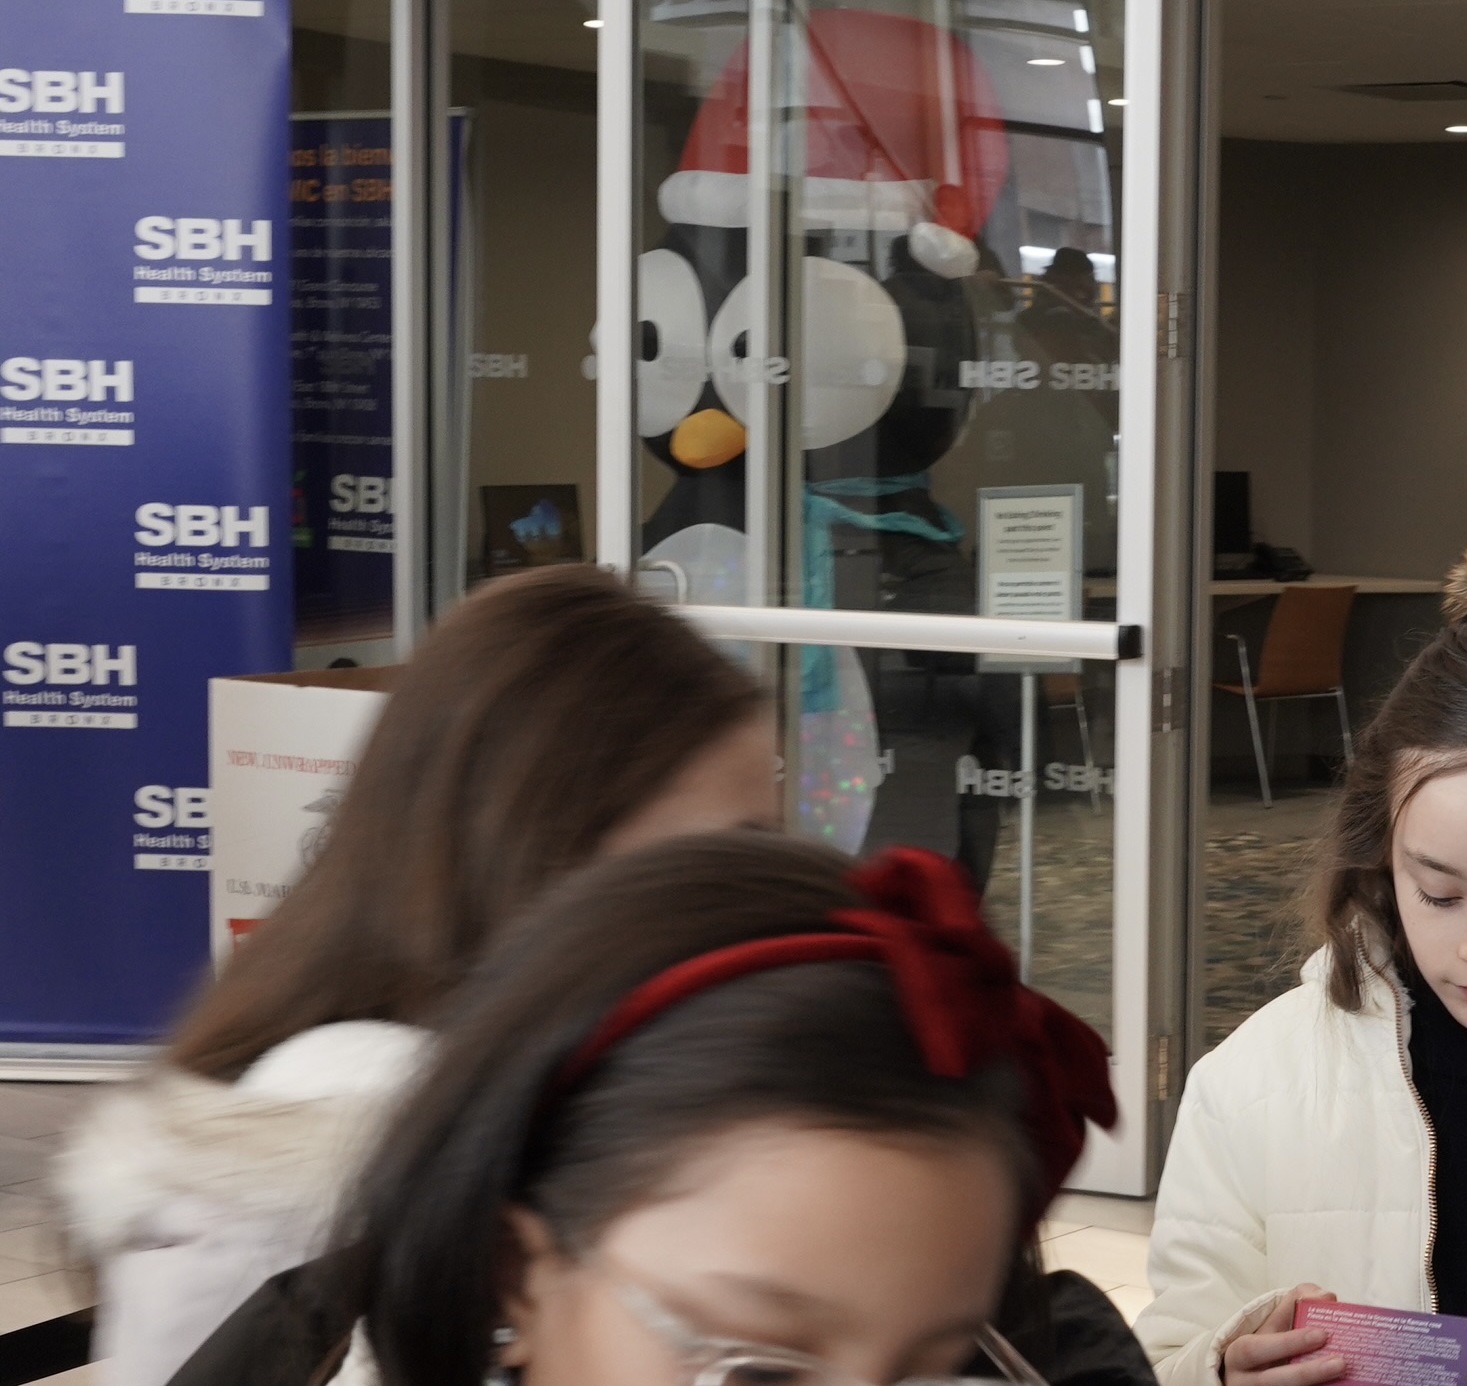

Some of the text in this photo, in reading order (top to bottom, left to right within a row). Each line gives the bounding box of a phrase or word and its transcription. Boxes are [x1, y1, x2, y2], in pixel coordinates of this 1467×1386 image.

[55, 121, 126, 137] System
[133, 216, 272, 261] SBH
[133, 266, 273, 284] Health System
[0, 357, 133, 403] SBH
[0, 407, 134, 425] Health System
[330, 474, 392, 513] SB
[134, 503, 269, 547] SBH
[134, 553, 269, 570] Health System
[3, 642, 136, 686] SBH
[3, 691, 137, 708] Health System
[134, 786, 213, 828] SB
[134, 834, 193, 849] Health
